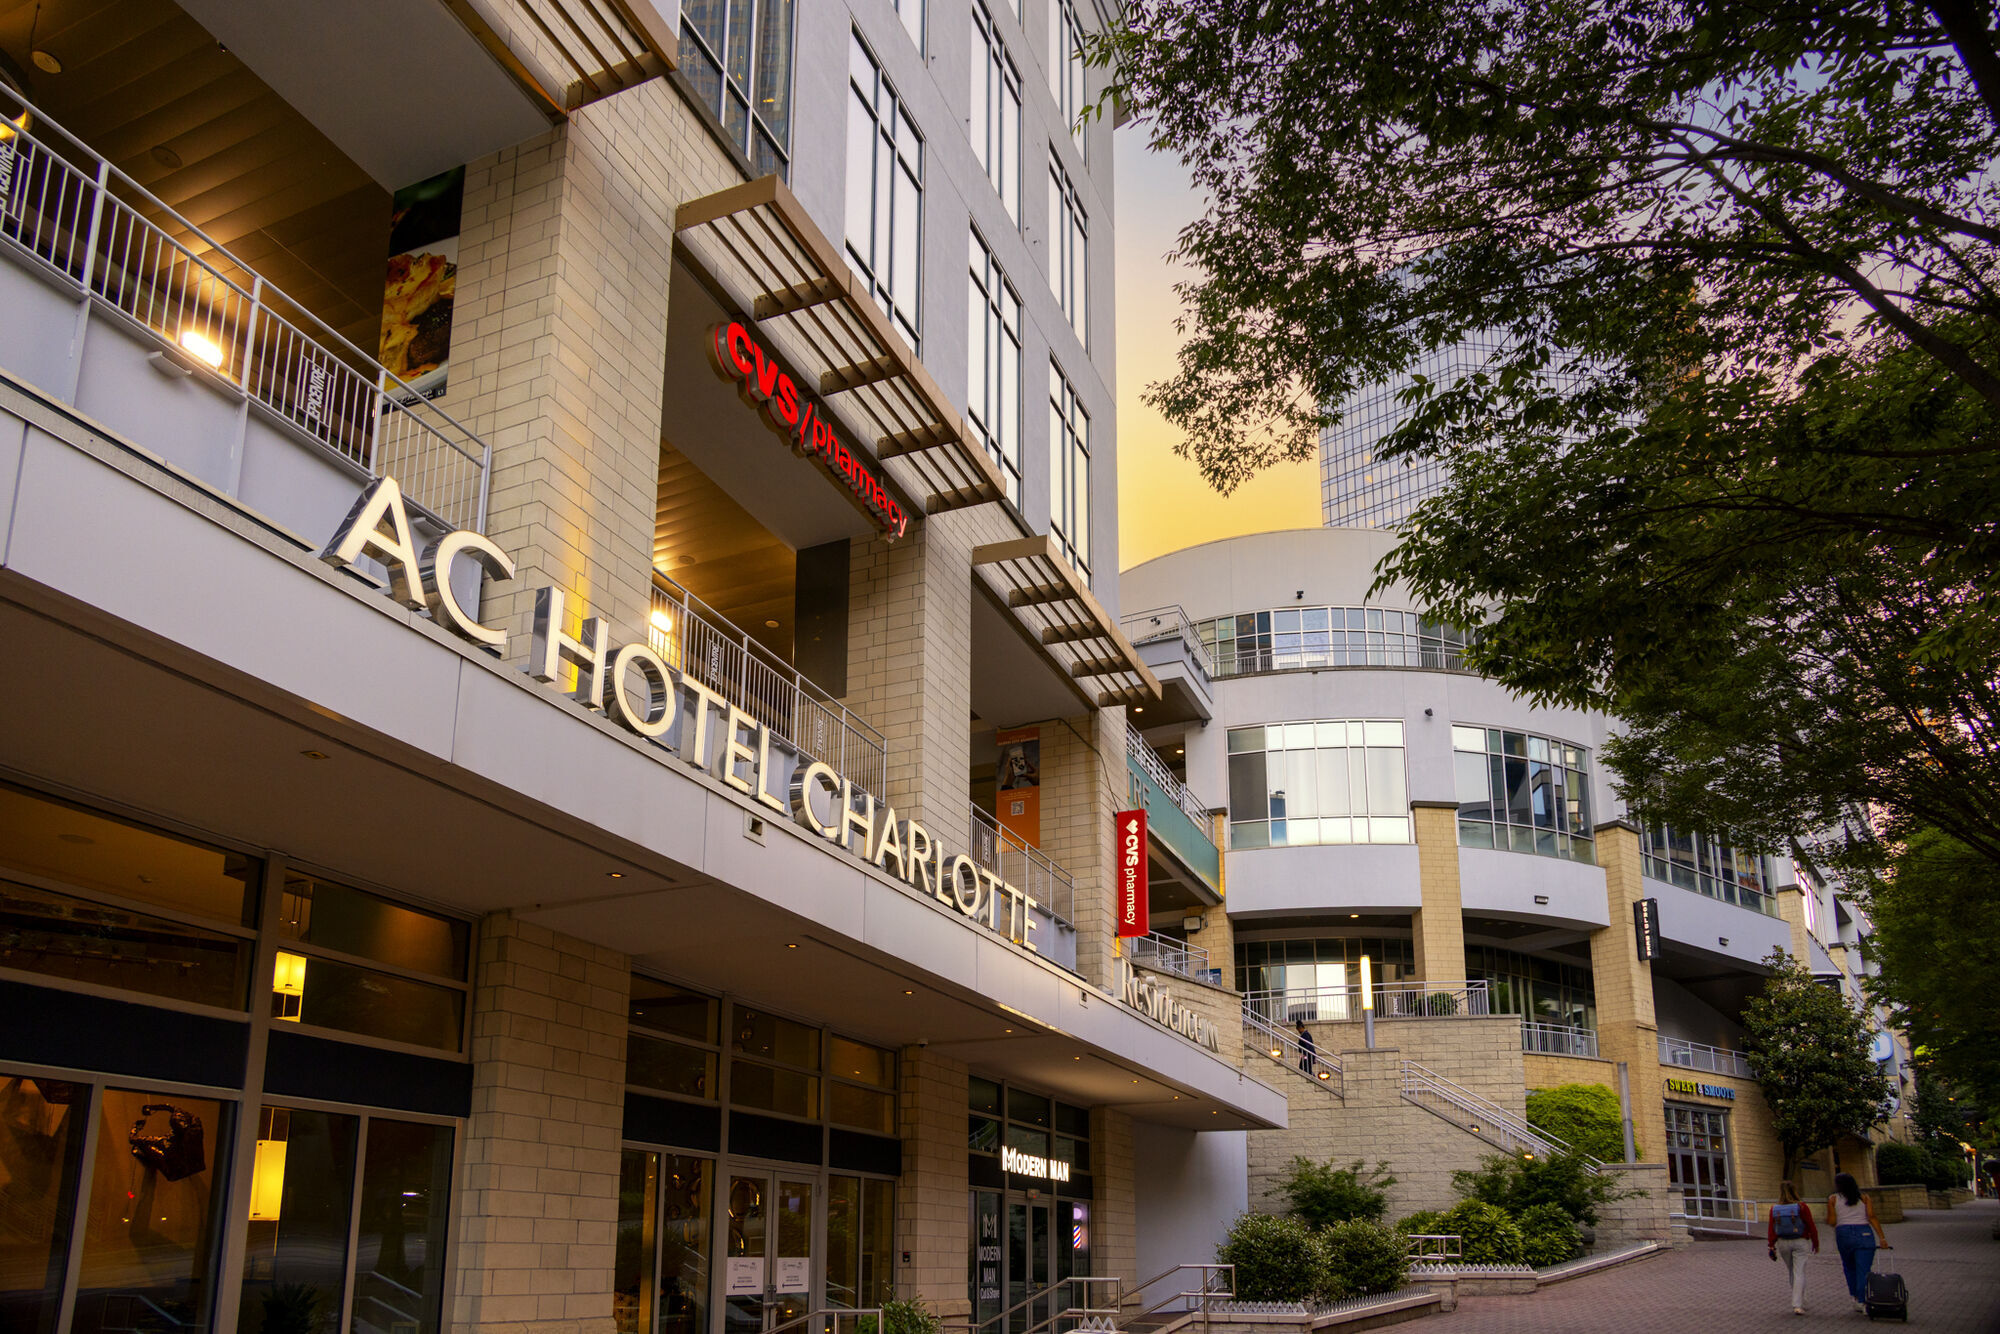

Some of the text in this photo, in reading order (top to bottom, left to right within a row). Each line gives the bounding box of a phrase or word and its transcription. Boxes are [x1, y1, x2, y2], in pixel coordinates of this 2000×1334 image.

[307, 367, 326, 419] EPICENTRE
[328, 475, 1038, 952] AC HOTEL CHARLOTTE
[1124, 834, 1139, 925] CVS pharmacy
[1669, 1079, 1736, 1100] SWEET & SMOOTH
[1001, 1145, 1070, 1182] MODERN MAN
[983, 1267, 996, 1283] MAN
